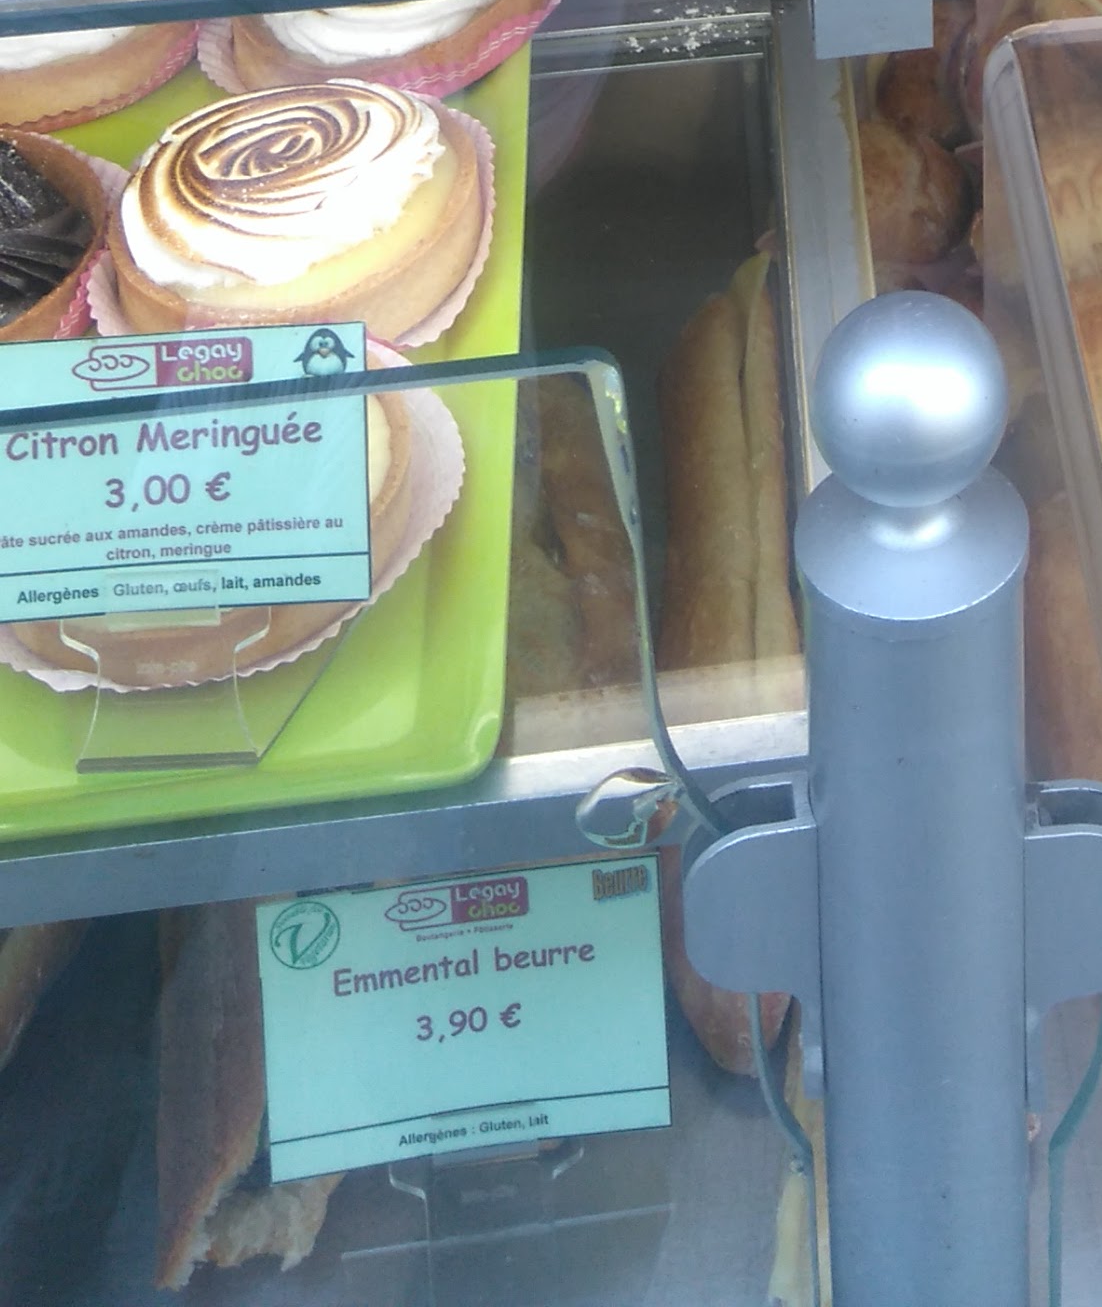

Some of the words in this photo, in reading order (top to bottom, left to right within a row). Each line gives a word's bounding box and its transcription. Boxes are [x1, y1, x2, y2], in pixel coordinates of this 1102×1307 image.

[161, 340, 243, 364] Legay
[176, 361, 244, 381] choc
[6, 432, 119, 461] Citron
[136, 411, 323, 456] Meringuée
[105, 473, 191, 512] 3,00
[205, 471, 231, 502] €
[0, 534, 24, 549] âte
[28, 529, 81, 547] sucrée
[85, 530, 112, 543] aux
[118, 523, 192, 540] amandes,
[196, 520, 242, 535] crème
[247, 517, 320, 536] pâtissière
[326, 516, 344, 529] au
[106, 545, 156, 561] citron,
[160, 542, 232, 561] meringue
[17, 586, 99, 606] Allergènes
[113, 581, 169, 597] Gluten,
[221, 576, 249, 591] lait,
[253, 573, 322, 589] amandes
[455, 881, 520, 901] Legay
[468, 900, 521, 919] choc
[332, 949, 480, 997] Emmental
[494, 941, 596, 972] beurre
[416, 1005, 489, 1043] 3,90
[500, 1003, 522, 1028] €
[399, 1126, 468, 1147] Allergènes
[479, 1118, 525, 1134] Gluten,
[529, 1113, 549, 1128] lait
